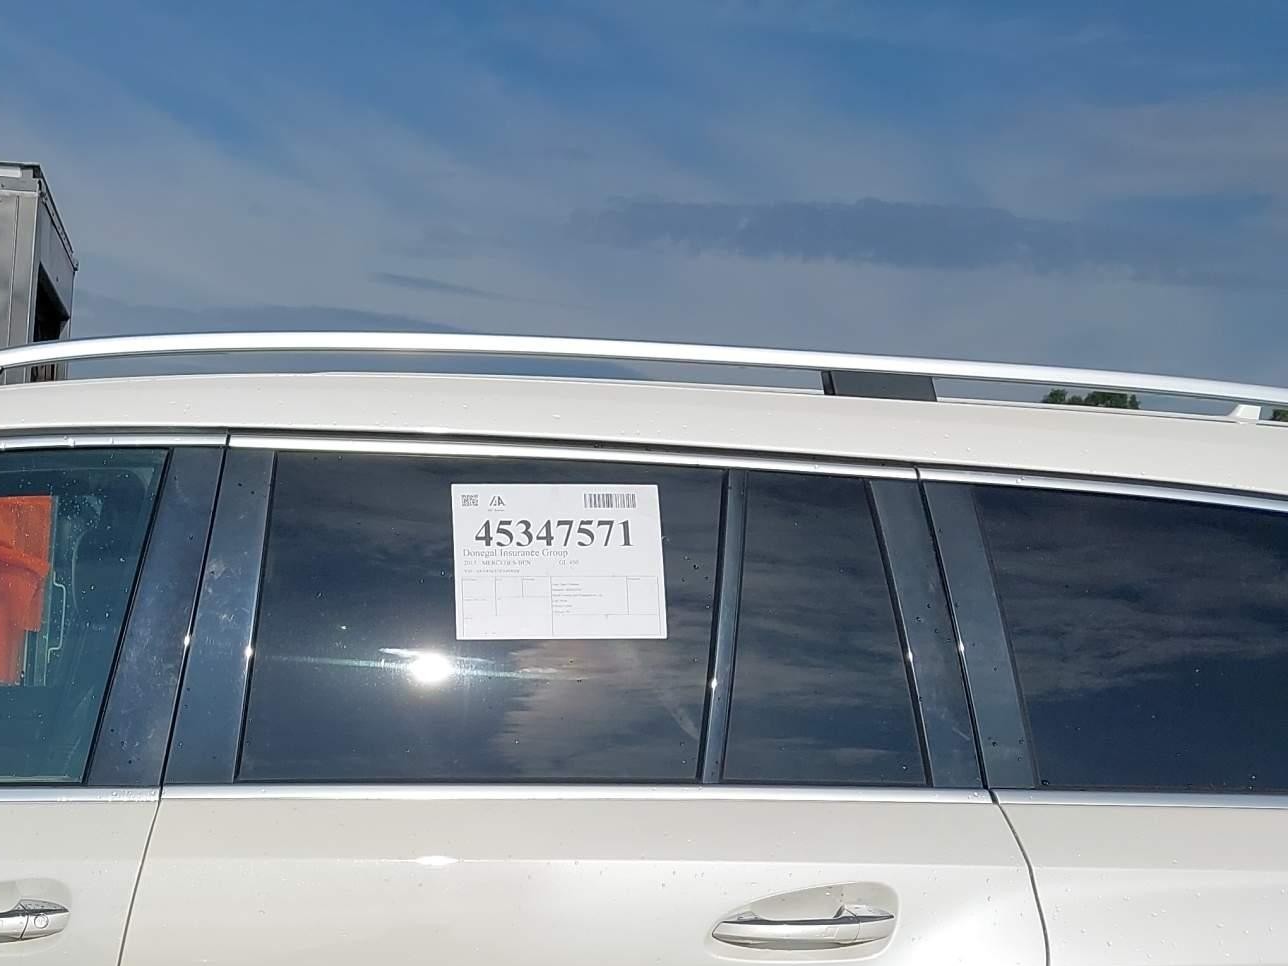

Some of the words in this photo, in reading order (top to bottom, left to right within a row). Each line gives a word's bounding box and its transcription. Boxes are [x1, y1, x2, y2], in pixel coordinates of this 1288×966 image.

[475, 519, 633, 547] 45347571
[463, 549, 497, 558] Donegal
[500, 549, 540, 557] Insurance
[542, 549, 569, 559] Group
